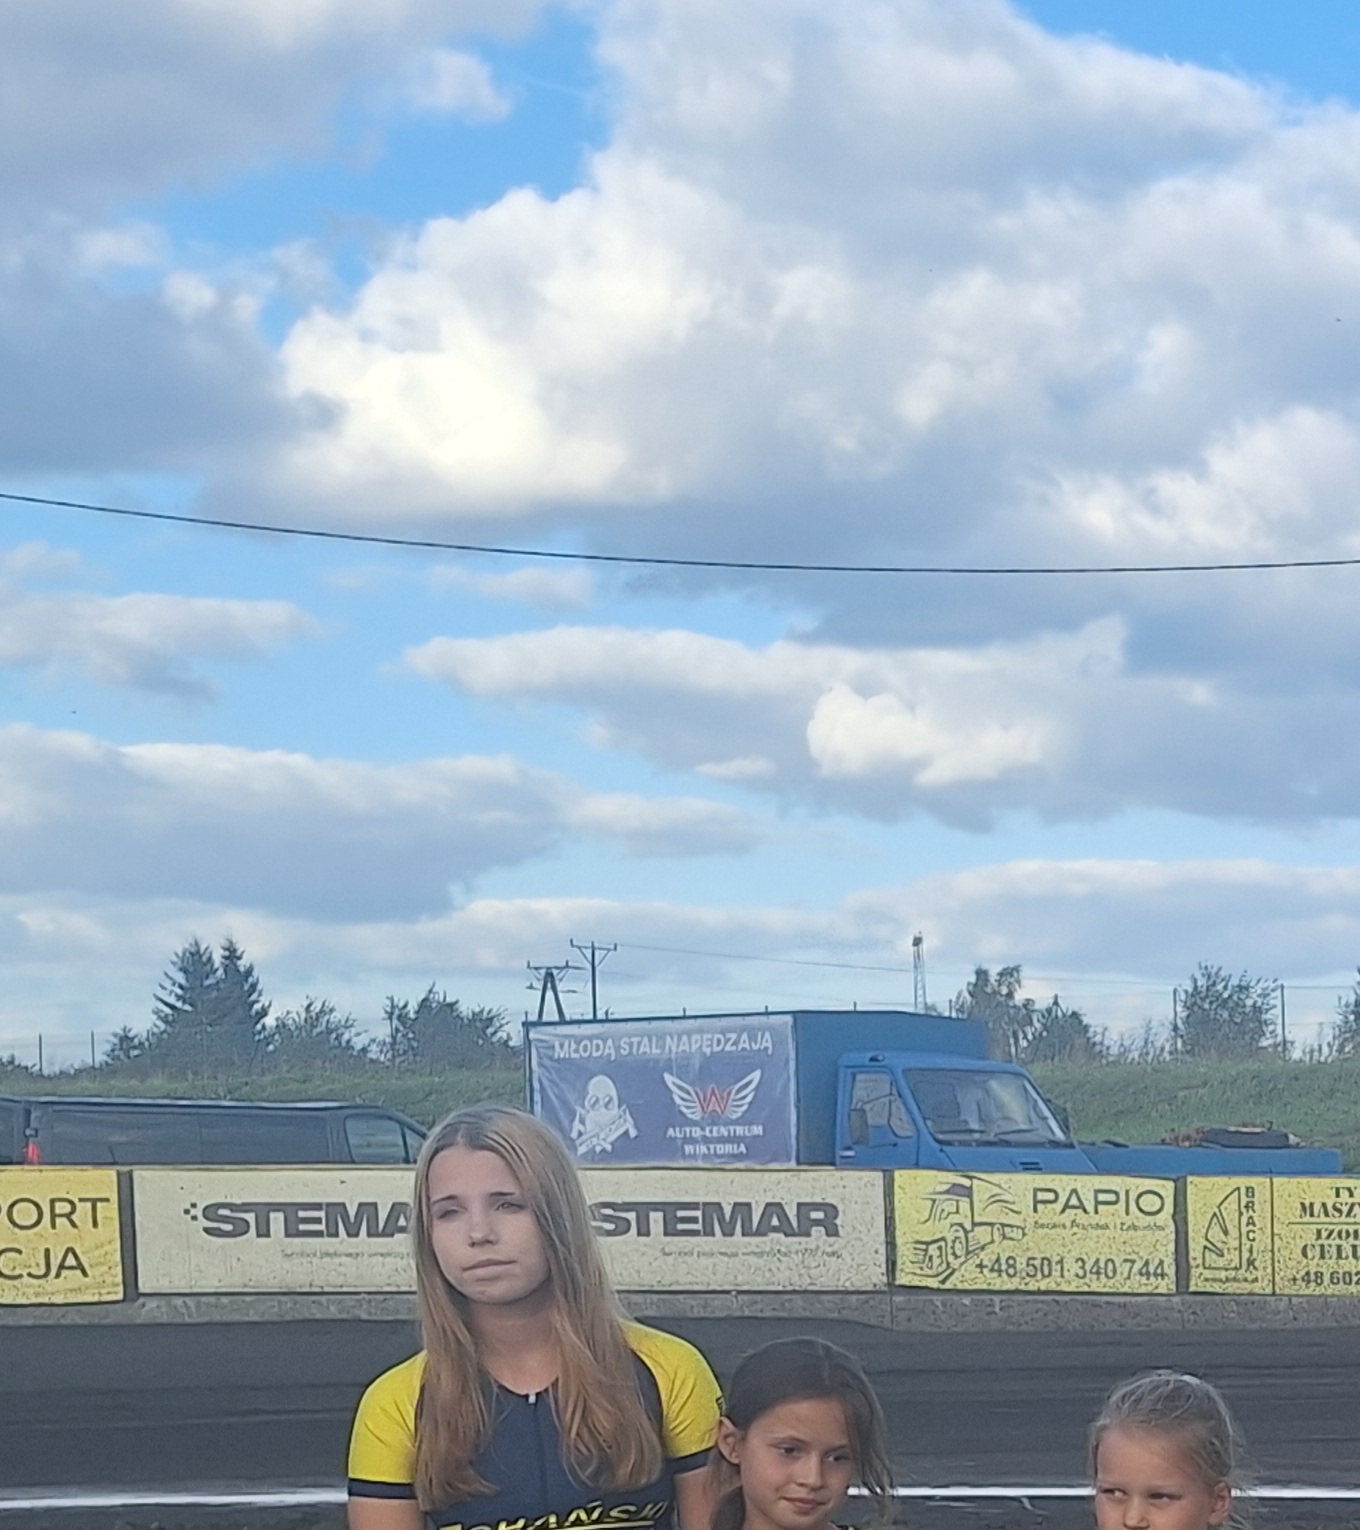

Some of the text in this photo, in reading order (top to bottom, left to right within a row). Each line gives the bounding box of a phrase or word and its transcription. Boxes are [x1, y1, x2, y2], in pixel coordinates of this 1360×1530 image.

[553, 1031, 773, 1062] MŁODĄ STAL NAPĘDZAJĄ
[666, 1124, 764, 1138] AUTO-CENTRUM
[683, 1143, 748, 1156] WIKTORIA
[0, 1197, 110, 1230] ORT
[1032, 1186, 1166, 1217] PAPIO
[201, 1201, 413, 1239] STEMA
[589, 1201, 841, 1238] STEMAR
[974, 1255, 1167, 1281] +48 501 340 744
